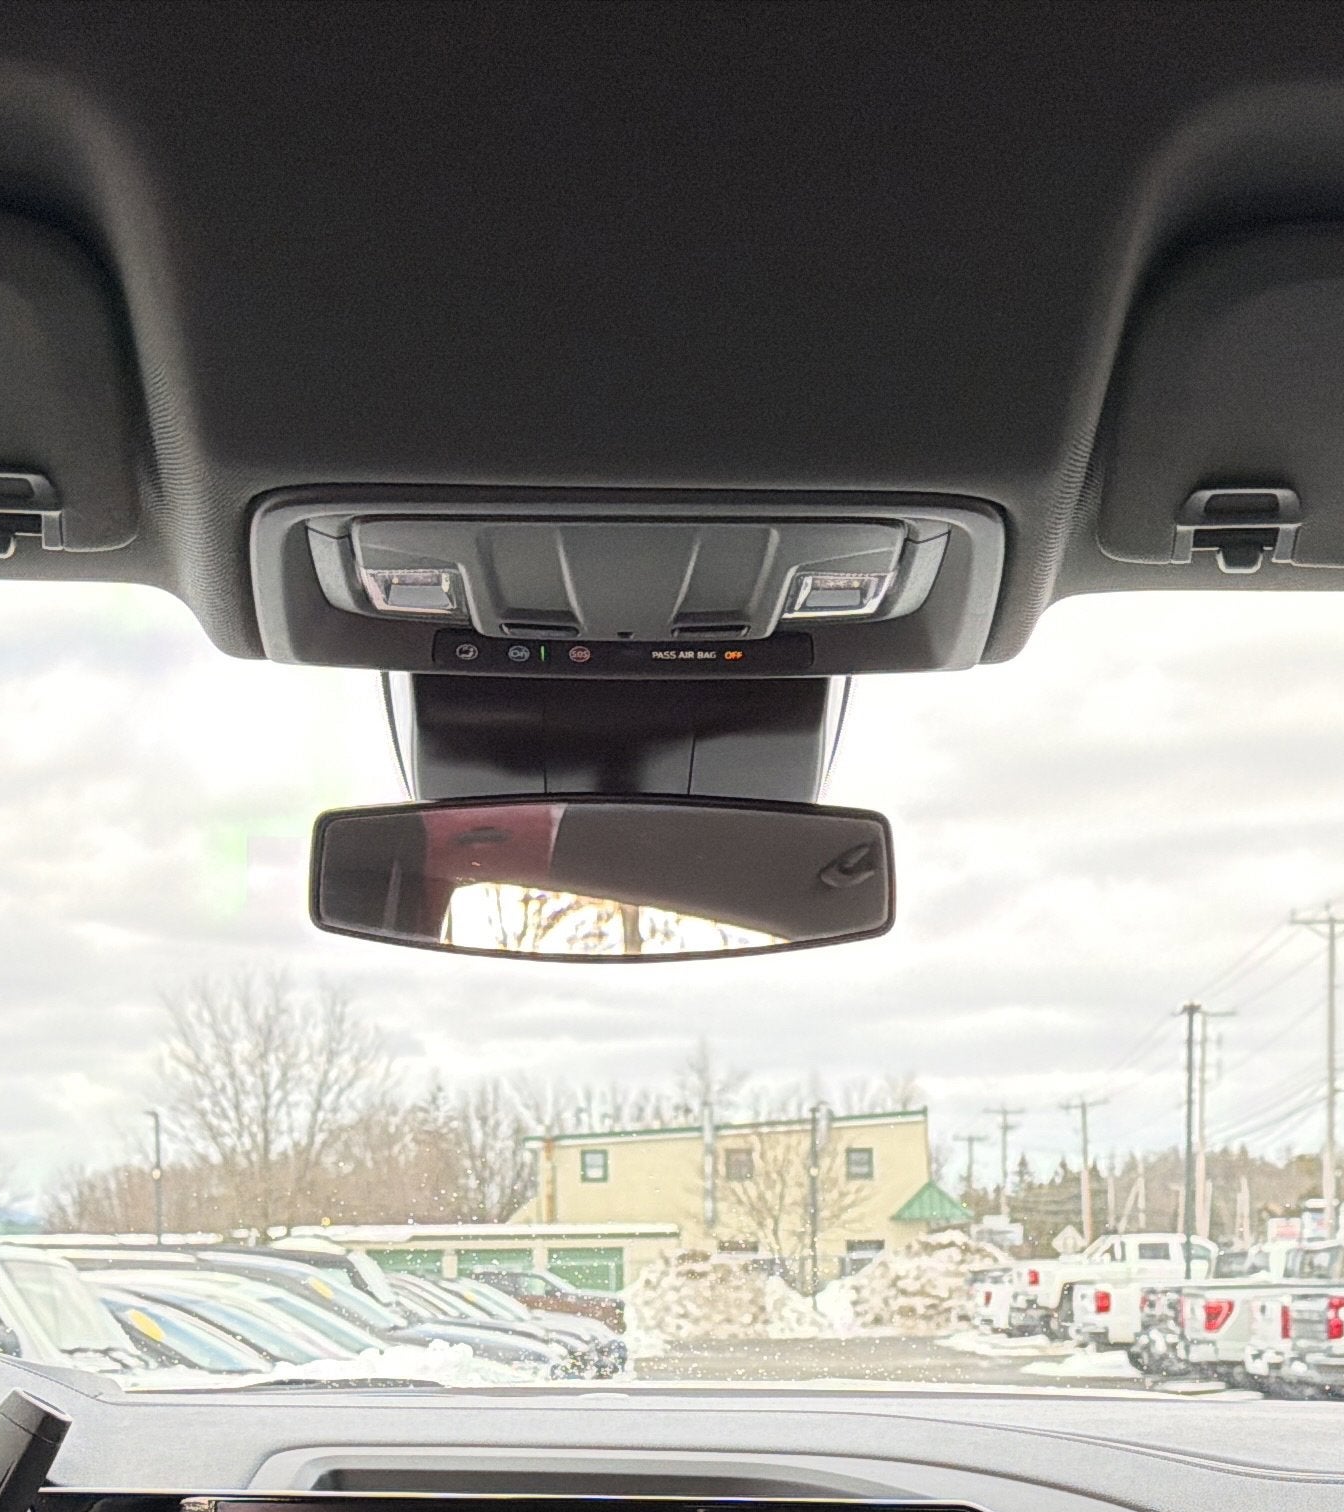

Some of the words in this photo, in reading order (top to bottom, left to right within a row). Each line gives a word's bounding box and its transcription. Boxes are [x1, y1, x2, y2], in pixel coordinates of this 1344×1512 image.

[652, 651, 676, 660] PASS
[678, 651, 694, 659] AIR
[697, 651, 716, 660] BAG
[724, 651, 742, 660] OFF
